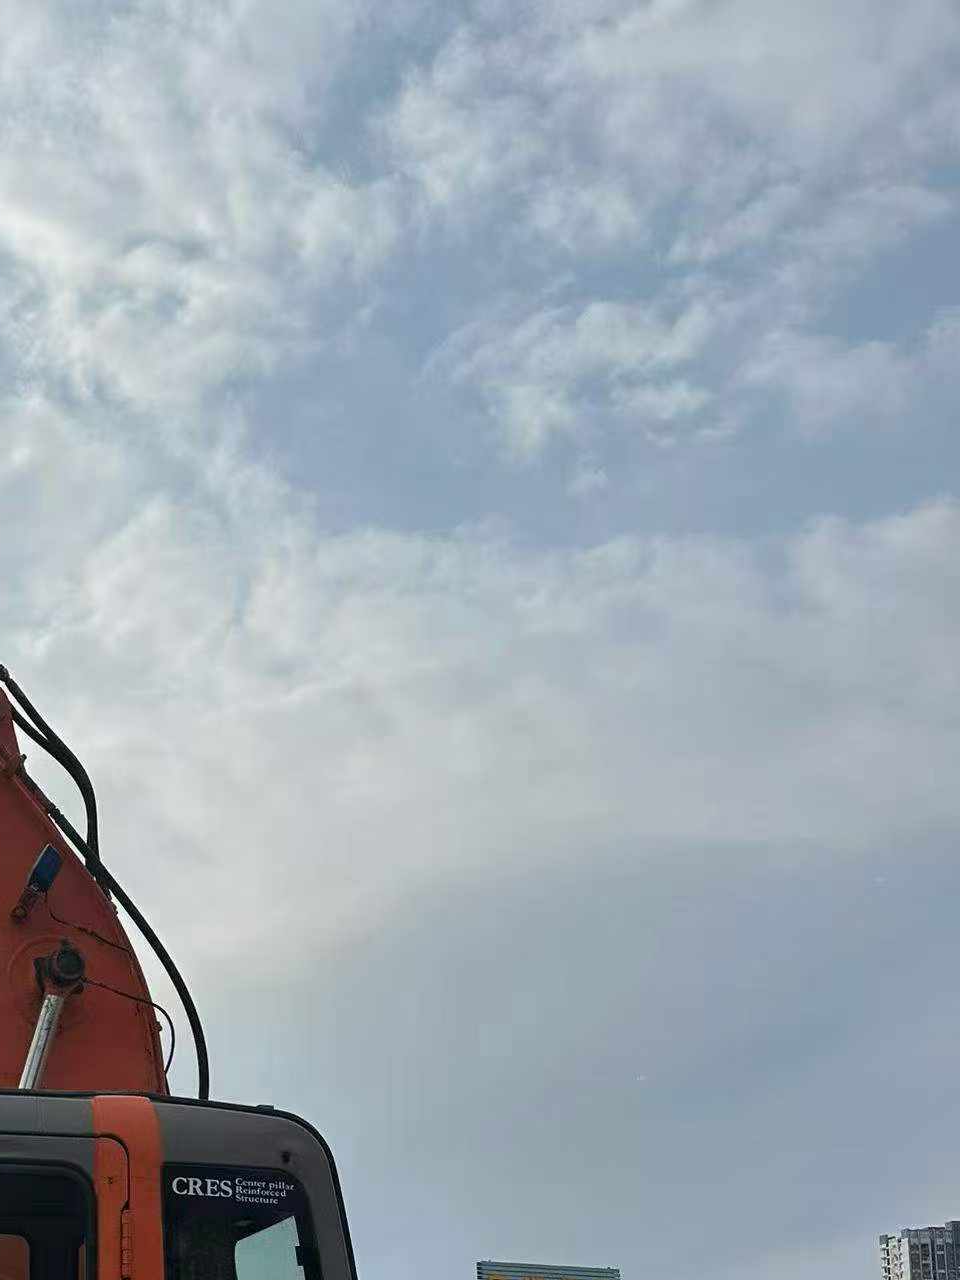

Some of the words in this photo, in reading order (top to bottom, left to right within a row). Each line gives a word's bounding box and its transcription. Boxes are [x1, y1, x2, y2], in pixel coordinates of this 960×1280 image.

[171, 1176, 234, 1198] CRES
[235, 1177, 266, 1189] Center
[269, 1181, 295, 1192] pillar
[235, 1186, 287, 1198] Reinforced
[235, 1194, 279, 1205] Structure
